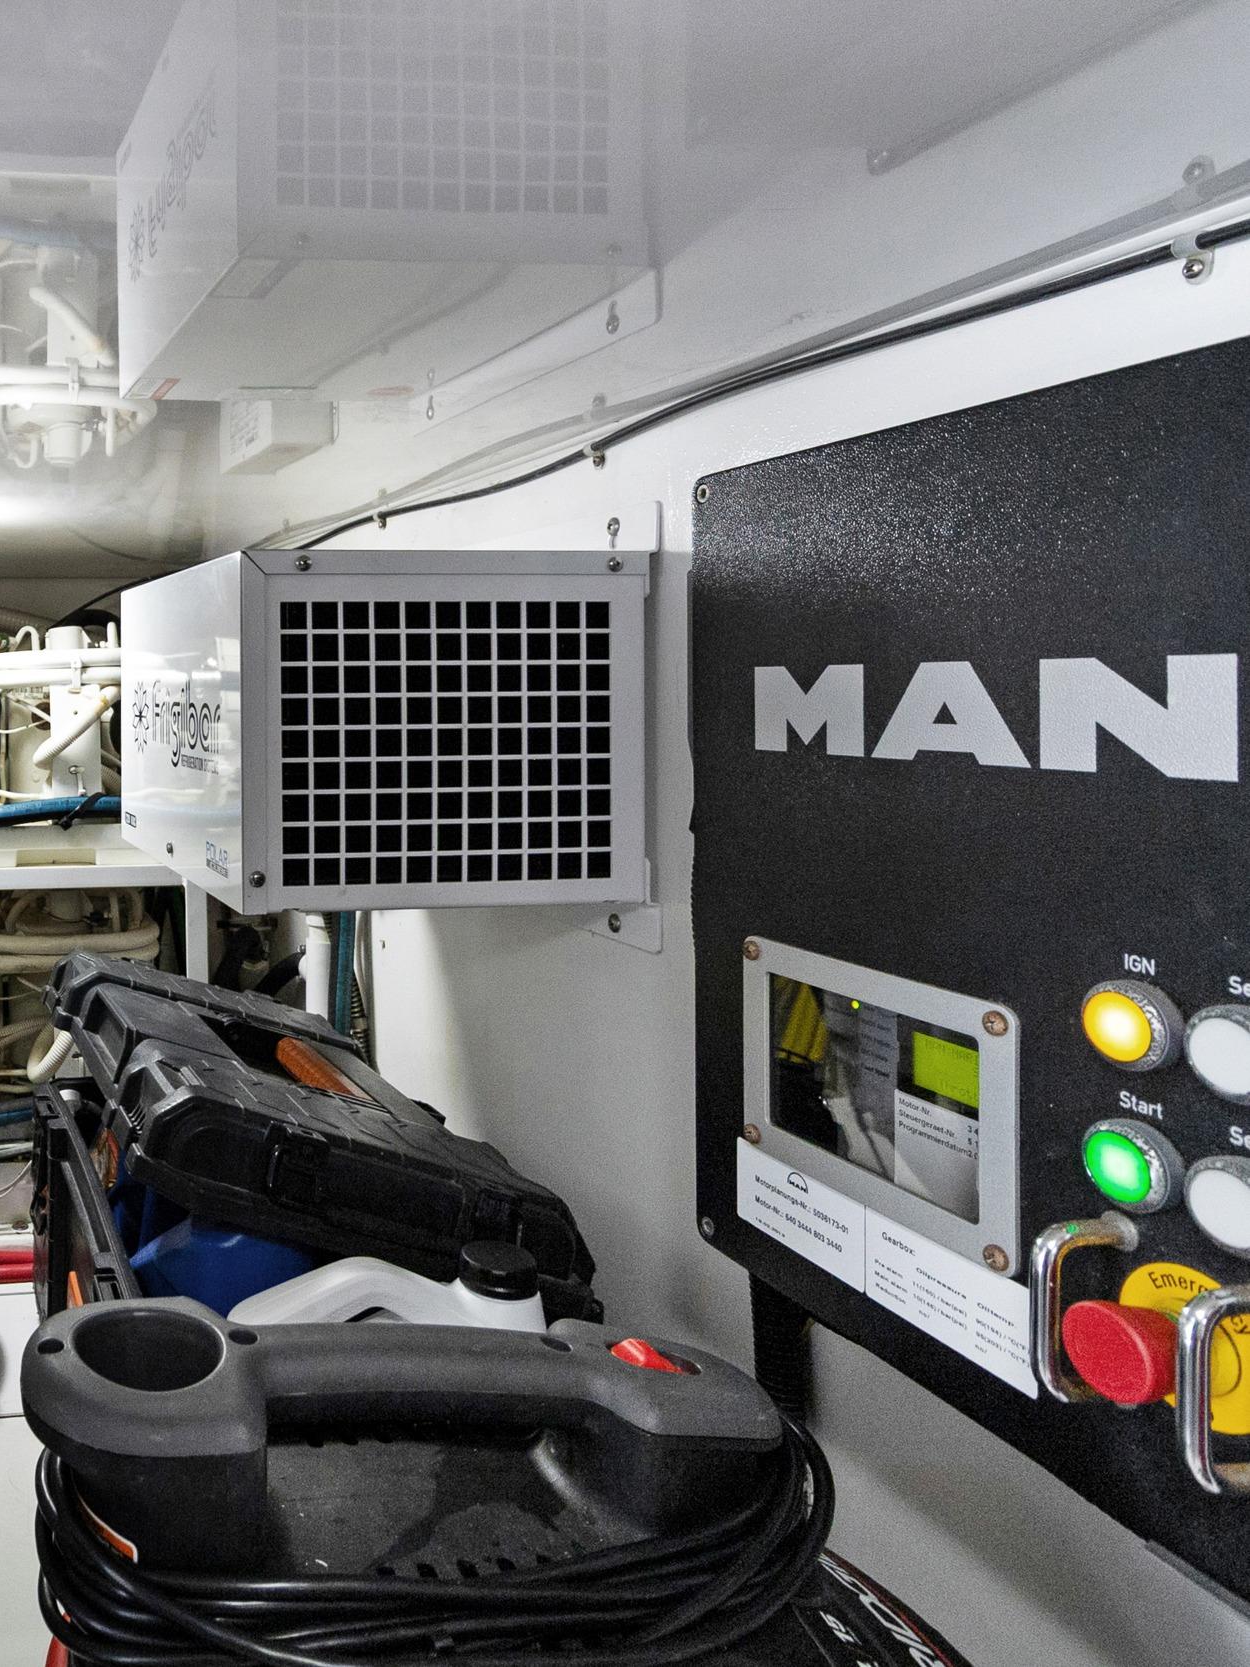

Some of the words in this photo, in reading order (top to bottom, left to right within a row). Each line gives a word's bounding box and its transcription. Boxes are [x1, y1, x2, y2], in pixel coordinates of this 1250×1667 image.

[754, 652, 1238, 782] MAN
[1124, 953, 1155, 976] IGN
[1120, 1091, 1163, 1119] Start
[818, 1552, 944, 1667] RIDGI
